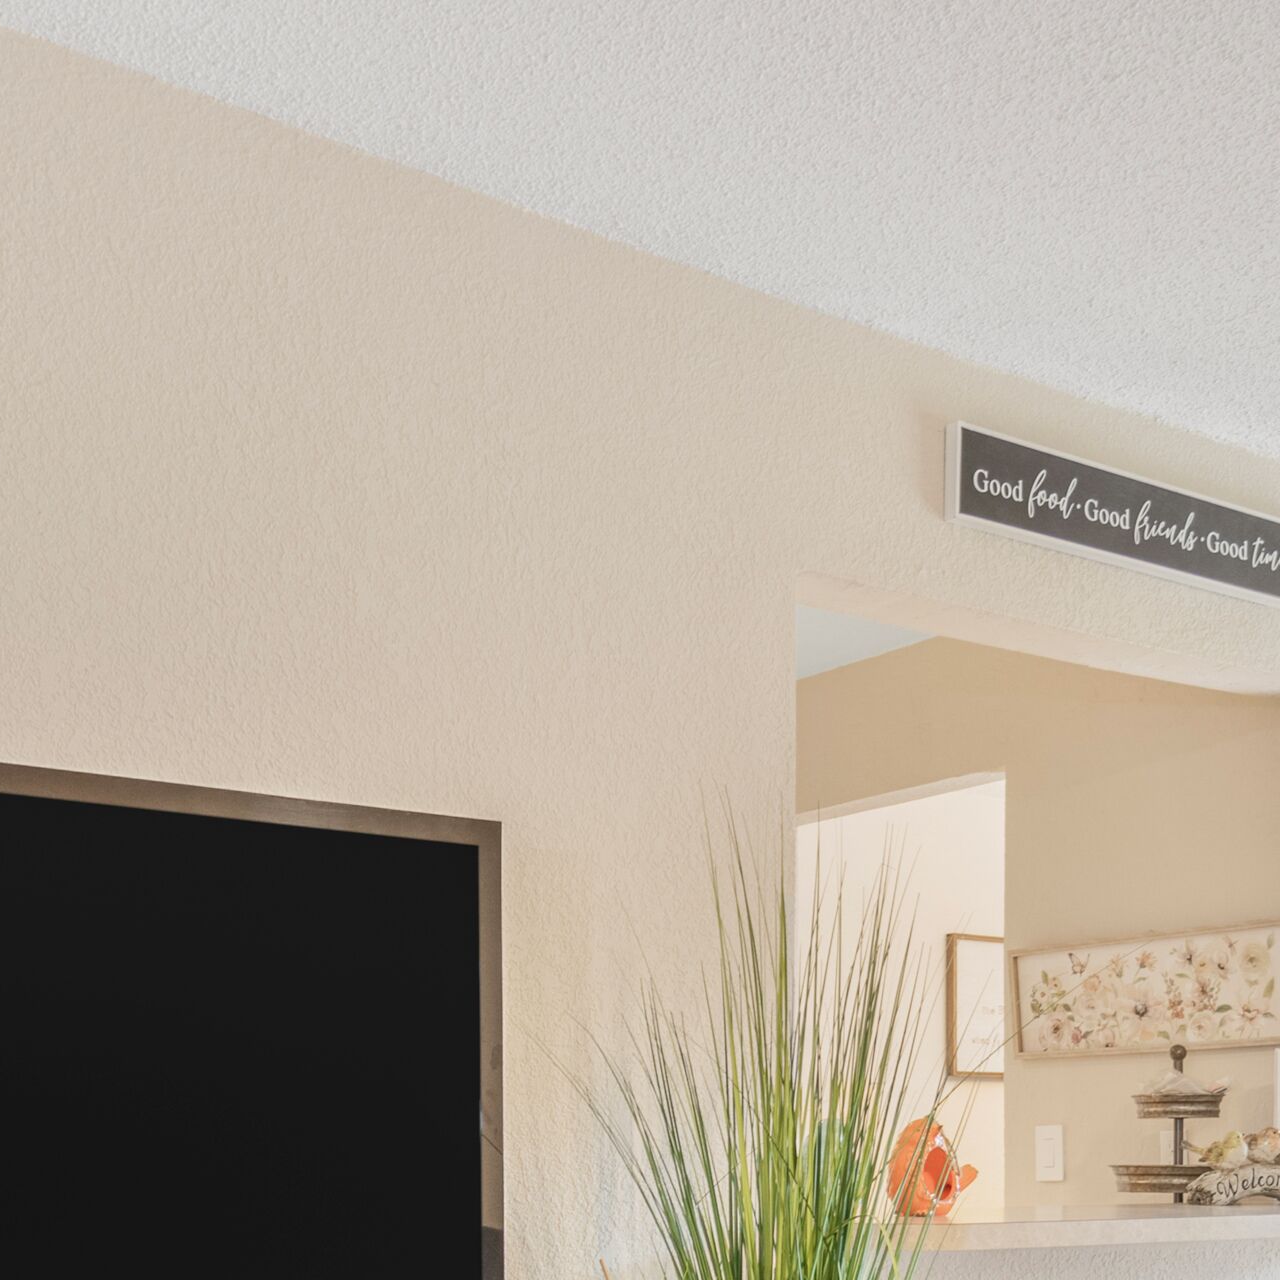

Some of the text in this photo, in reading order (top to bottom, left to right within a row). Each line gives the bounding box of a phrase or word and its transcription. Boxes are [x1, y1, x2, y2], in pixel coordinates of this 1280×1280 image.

[972, 468, 1024, 502] Good
[1027, 469, 1078, 519] food
[1084, 498, 1130, 530] Good
[1133, 500, 1198, 552] friends
[1206, 531, 1248, 561] Good
